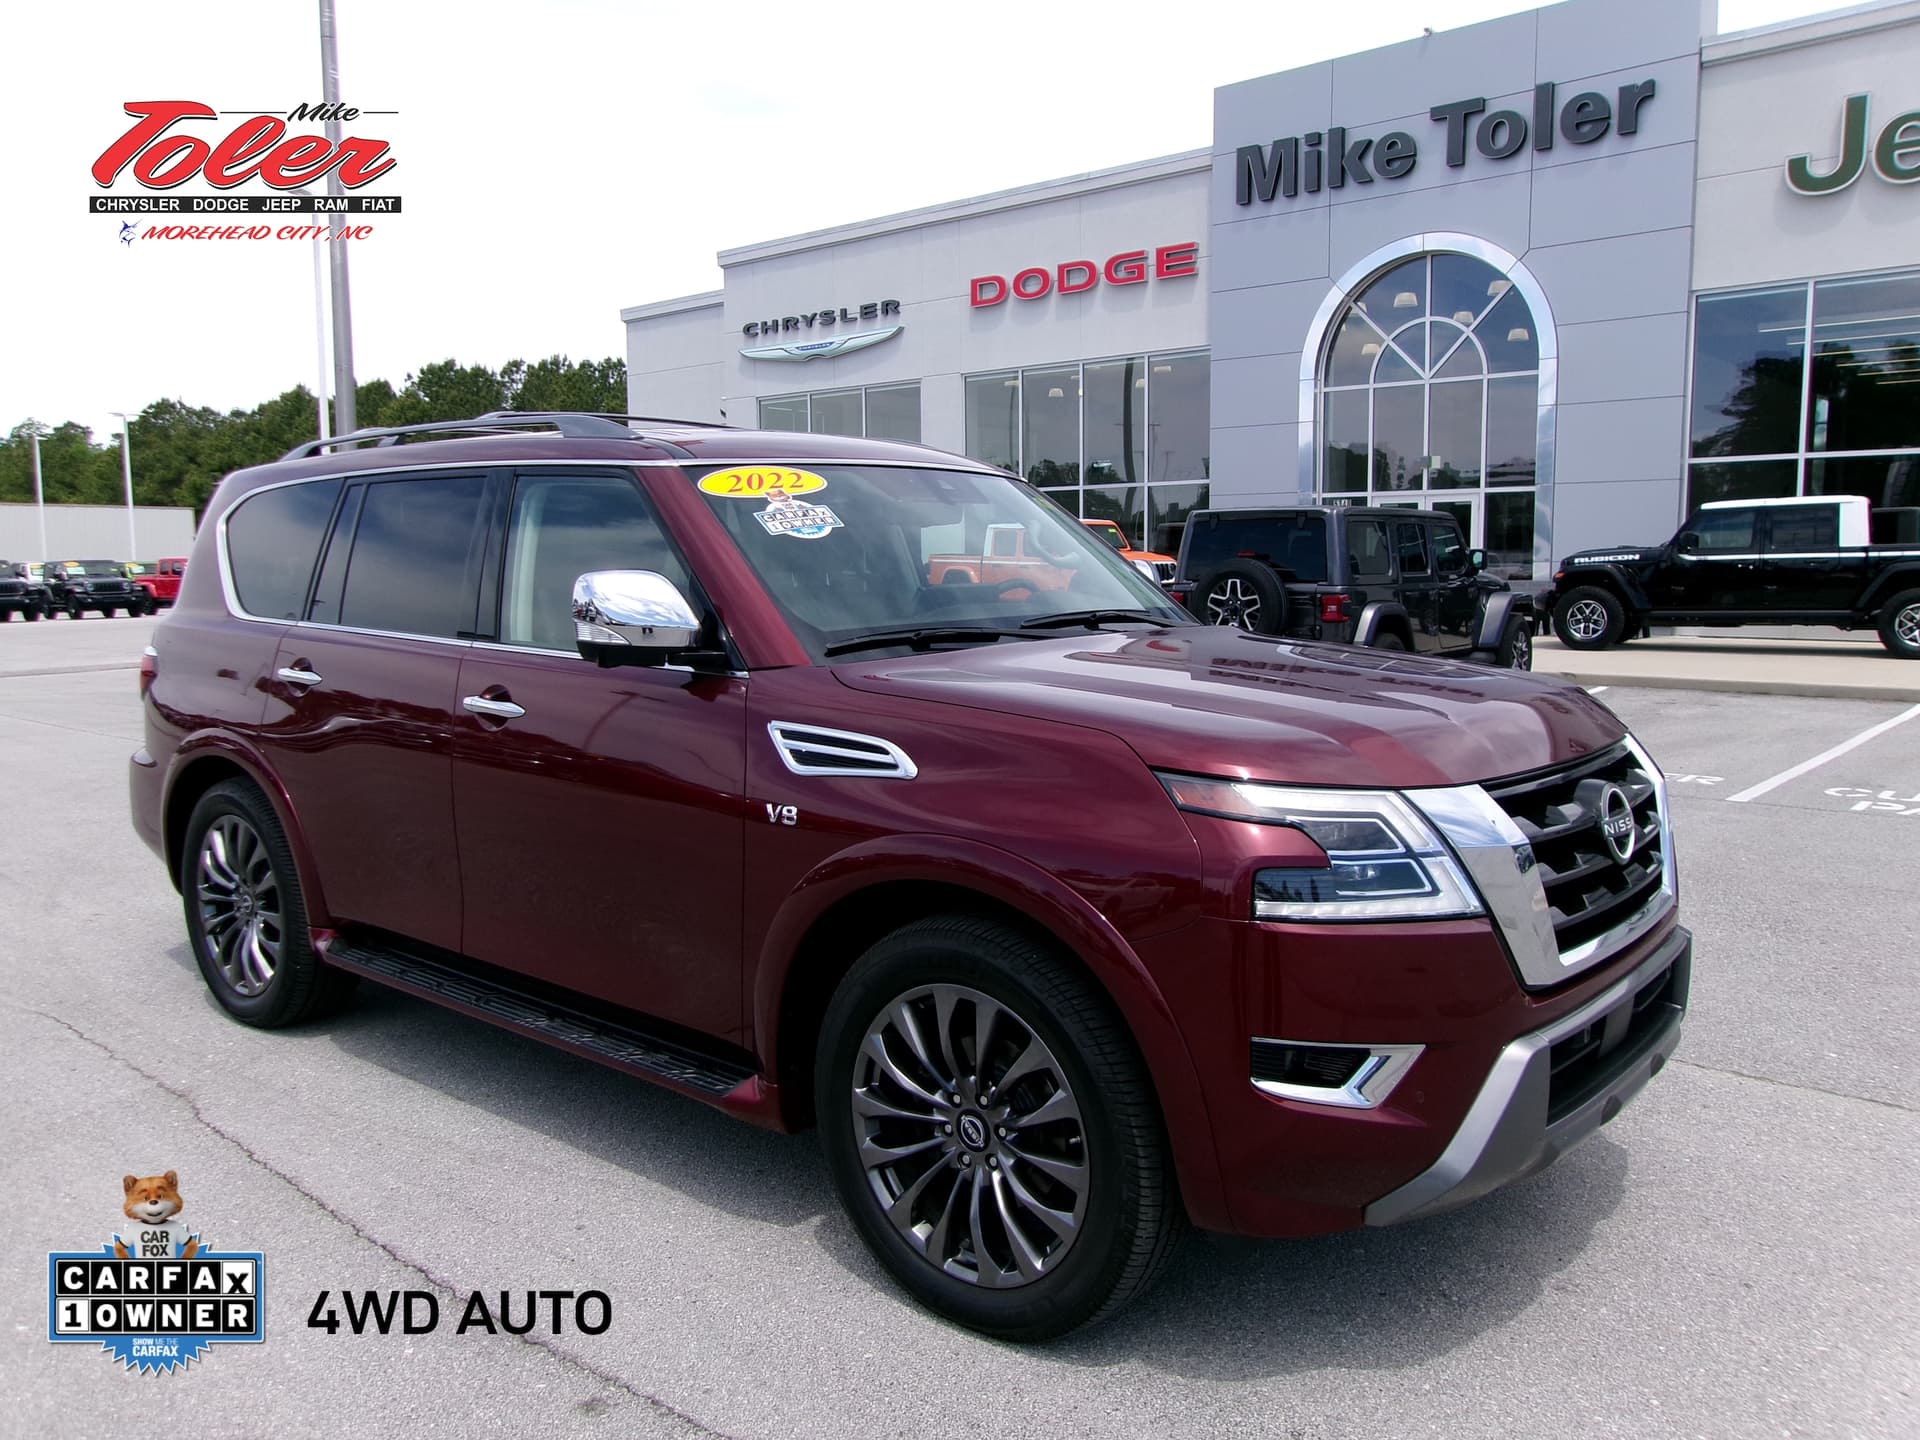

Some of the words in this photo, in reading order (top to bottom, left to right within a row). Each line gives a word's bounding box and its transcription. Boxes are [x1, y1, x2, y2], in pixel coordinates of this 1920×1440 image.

[1235, 127, 1417, 205] Mike
[1430, 79, 1656, 167] Toler
[970, 241, 1199, 309] DODGE
[742, 300, 901, 337] CHRYSLER
[727, 472, 804, 493] 2022
[1574, 554, 1640, 564] RUBICON
[766, 803, 798, 825] V8
